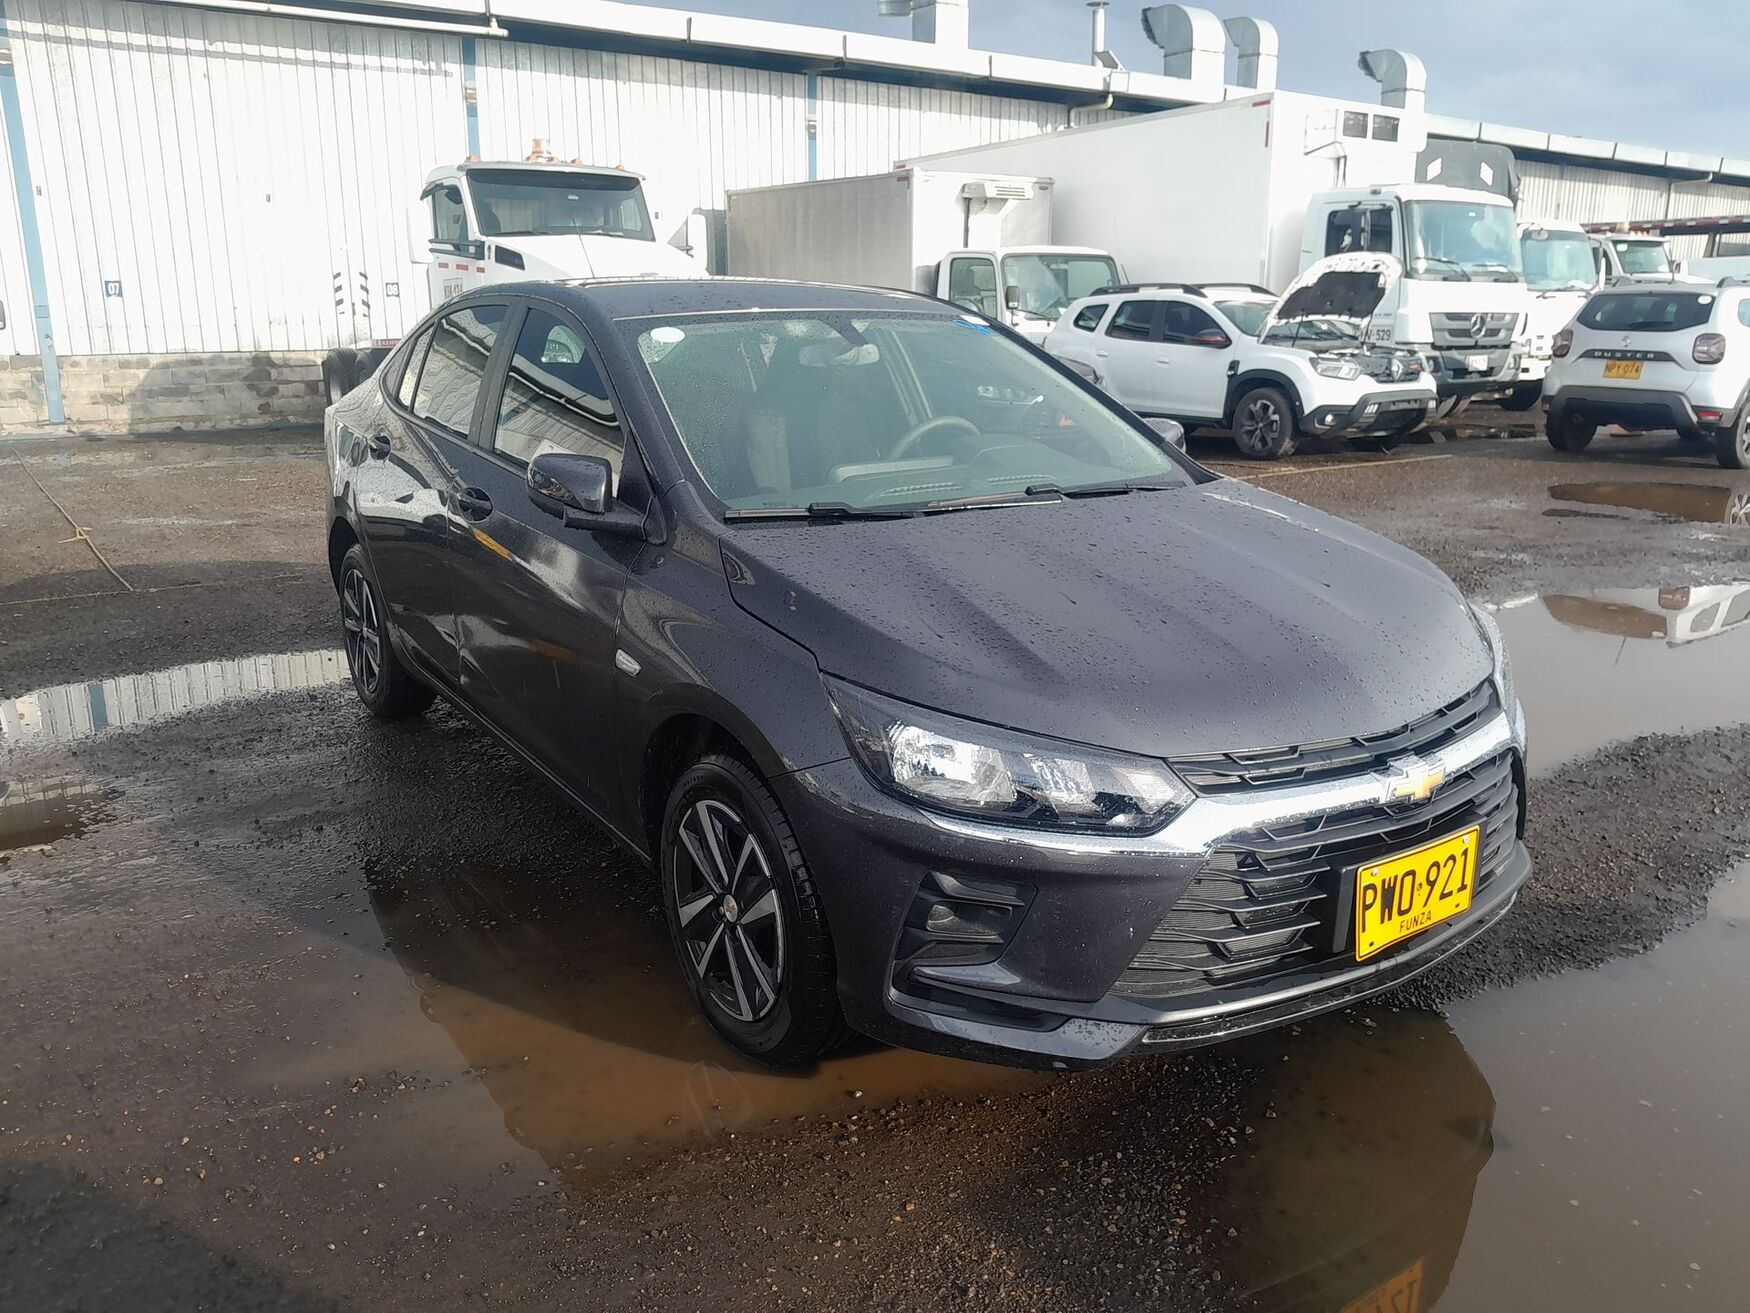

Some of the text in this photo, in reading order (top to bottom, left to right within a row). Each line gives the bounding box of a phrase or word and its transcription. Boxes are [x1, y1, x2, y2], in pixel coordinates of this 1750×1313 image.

[107, 282, 120, 295] 07
[386, 284, 398, 296] 08
[1594, 351, 1655, 359] DUSTER
[1399, 909, 1433, 933] FUNZA
